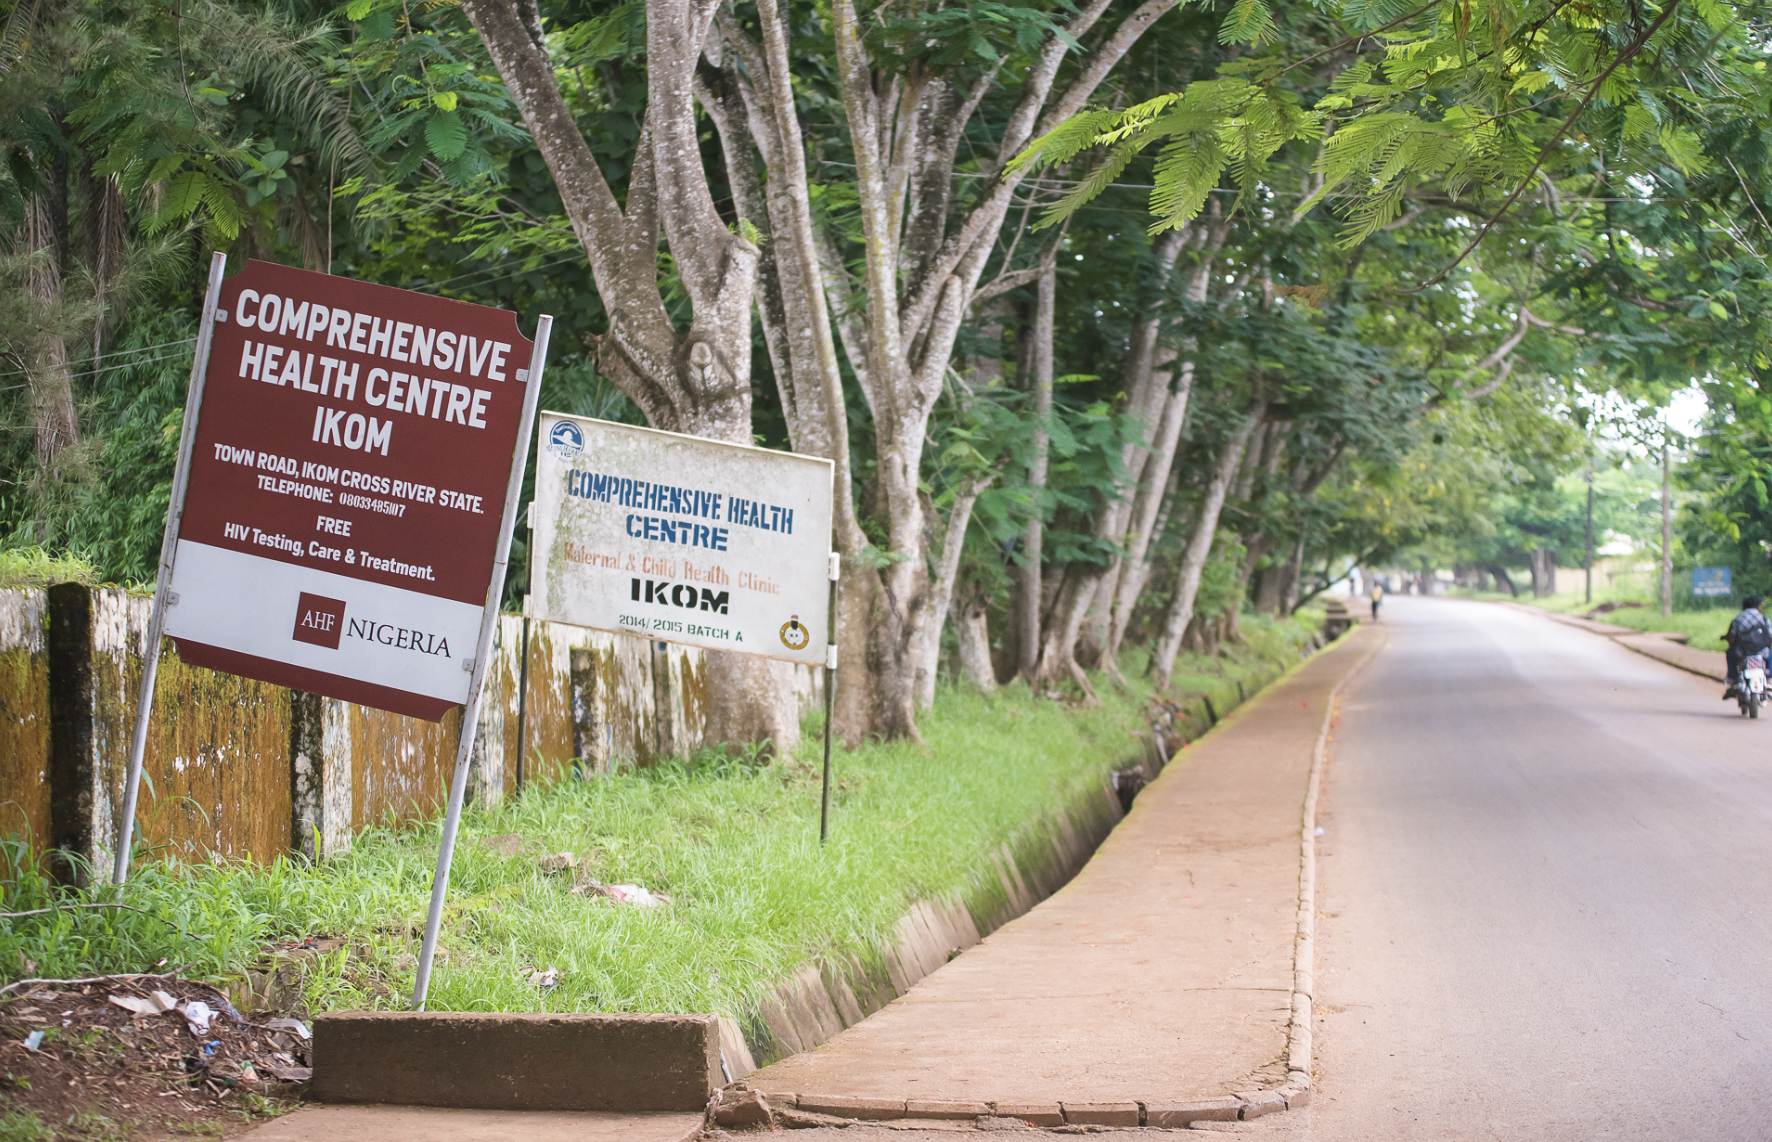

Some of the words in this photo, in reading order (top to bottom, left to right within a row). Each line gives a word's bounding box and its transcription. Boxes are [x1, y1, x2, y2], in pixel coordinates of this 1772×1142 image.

[235, 288, 512, 382] COMPREHENSIVE
[238, 340, 360, 401] HEALTH
[364, 367, 492, 429] CENTRE
[312, 406, 393, 456] IKOM
[214, 443, 255, 467] TOWN
[257, 452, 299, 478] ROAD,
[301, 461, 340, 484] IKOM
[340, 470, 391, 495] CROSS
[391, 479, 436, 504] RIVER
[439, 490, 484, 514] STATE.
[257, 475, 334, 504] TELEPHONE:
[567, 468, 722, 520] COMPREHENSIVE
[727, 496, 794, 535] HEALTH
[316, 515, 352, 537] FREE
[626, 514, 729, 552] CENTRE
[224, 521, 250, 541] HIV
[252, 528, 305, 556] Testing,
[308, 541, 342, 562] Care
[344, 549, 356, 564] &
[360, 551, 436, 582] Treatment.
[625, 553, 637, 573] &
[642, 555, 677, 579] Child
[684, 561, 730, 586] Health
[738, 570, 780, 595] Clinic
[631, 577, 729, 616] IKOM
[301, 609, 335, 632] AHF
[346, 617, 452, 659] NIGERIA
[653, 619, 683, 633] 2015
[687, 623, 729, 640] BATCH
[735, 631, 743, 643] A
